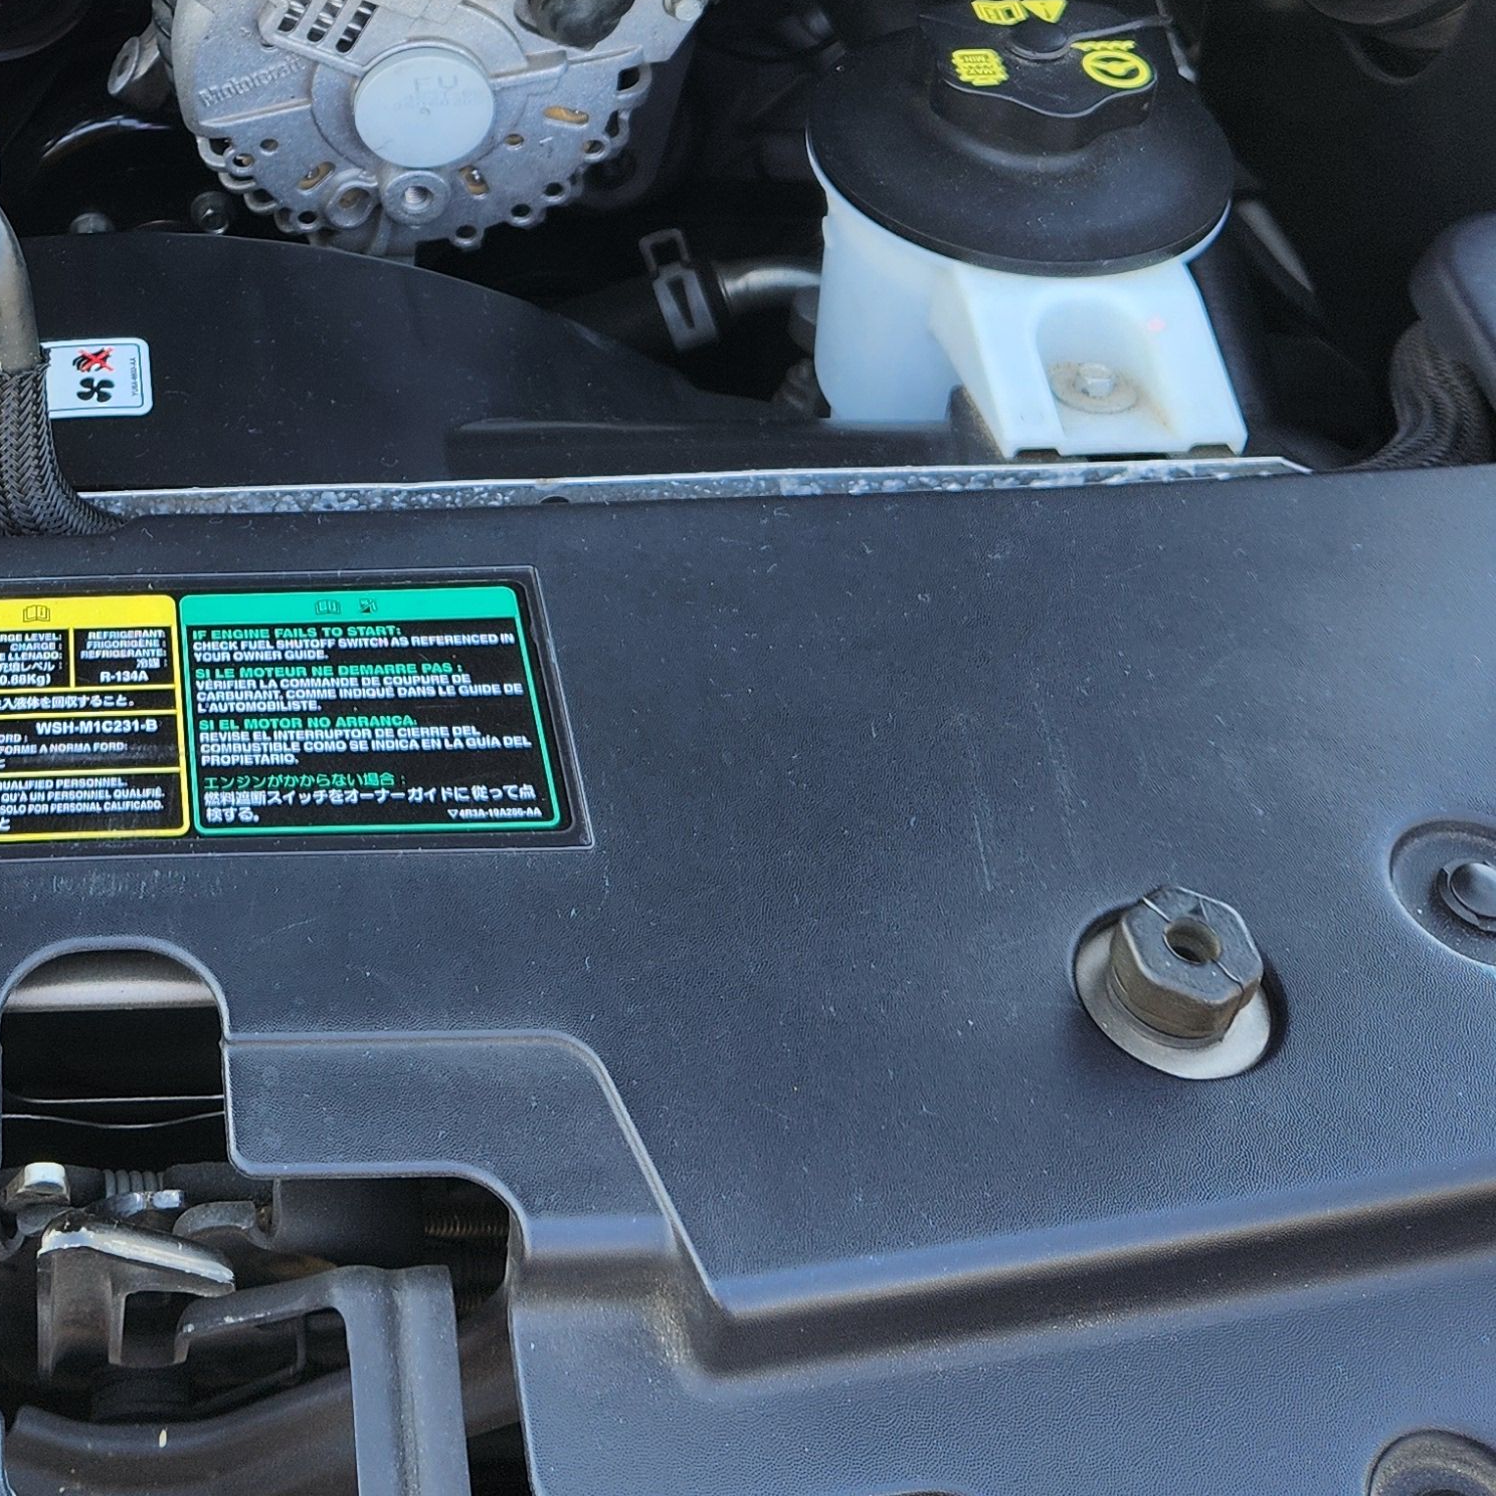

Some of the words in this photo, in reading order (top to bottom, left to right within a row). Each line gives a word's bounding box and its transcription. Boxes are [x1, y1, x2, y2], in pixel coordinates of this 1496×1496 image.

[25, 632, 62, 642] LEVEL:
[192, 630, 207, 640] IF
[211, 629, 270, 640] ENGINE
[274, 627, 317, 639] FAILS
[322, 627, 343, 637] TO
[347, 625, 401, 637] START:
[10, 642, 55, 652] CHARGE
[193, 640, 238, 652] CHECK
[240, 639, 275, 650] FUEL
[276, 638, 336, 650] SHUTOFF
[338, 637, 389, 649] SWITCH
[390, 637, 409, 647] AS
[411, 634, 498, 647] REFERENCED
[500, 633, 515, 644] IN
[8, 651, 62, 661] LLENADO:
[193, 652, 231, 662] YOUR
[233, 651, 282, 662] OWNER
[284, 649, 329, 661] GUIDE.
[100, 670, 149, 683] R-134A
[195, 668, 210, 679] SI
[215, 668, 235, 678] LE
[239, 666, 307, 678] MOTEUR
[311, 666, 333, 676] NE
[422, 662, 453, 674] PAS
[196, 677, 257, 691] VÉRIFIER
[259, 679, 278, 689] LA
[279, 677, 359, 689] COMMANDE
[361, 676, 380, 686] DE
[383, 674, 449, 686] COUPURE
[452, 674, 471, 684] DE
[285, 689, 337, 700] COMME
[339, 685, 395, 699] INDIQUÉ
[397, 686, 436, 697] DANS
[438, 686, 454, 696] LE
[458, 684, 502, 696] GUIDE
[504, 683, 523, 695] DE
[197, 700, 322, 713] L'AUTOMOBILISTE.
[35, 719, 158, 735] WSH-M1C231-B
[199, 720, 214, 730] SI
[219, 719, 239, 730] EL
[244, 718, 302, 730] MOTOR
[307, 717, 331, 728] NO
[199, 731, 250, 742] REVISE
[252, 730, 271, 741] EL
[273, 728, 372, 740] INTERRUPTOR
[375, 728, 394, 738] DE
[397, 726, 450, 738] CIERRE
[452, 725, 481, 736] DEL
[39, 744, 48, 753] A
[49, 743, 91, 753] NORMA
[92, 742, 128, 752] FORD:
[200, 741, 301, 754] COMBUSTIBLE
[303, 740, 347, 752] COMO
[349, 740, 369, 752] SE
[371, 738, 420, 750] INDICA
[421, 738, 442, 749] EN
[444, 738, 464, 749] LA
[465, 735, 501, 748] GUÍA
[503, 736, 532, 748] DEL
[201, 753, 299, 766] PROPIETARIO.
[56, 777, 127, 789] PERSONNEL.
[29, 792, 45, 802] UN
[47, 789, 112, 801] PERSONNEL
[113, 786, 165, 799] QUALIFIÉ.
[0, 805, 26, 815] SOLO
[27, 804, 49, 814] POR
[50, 802, 103, 814] PERSONAL
[104, 800, 164, 812] CALIFICADO.
